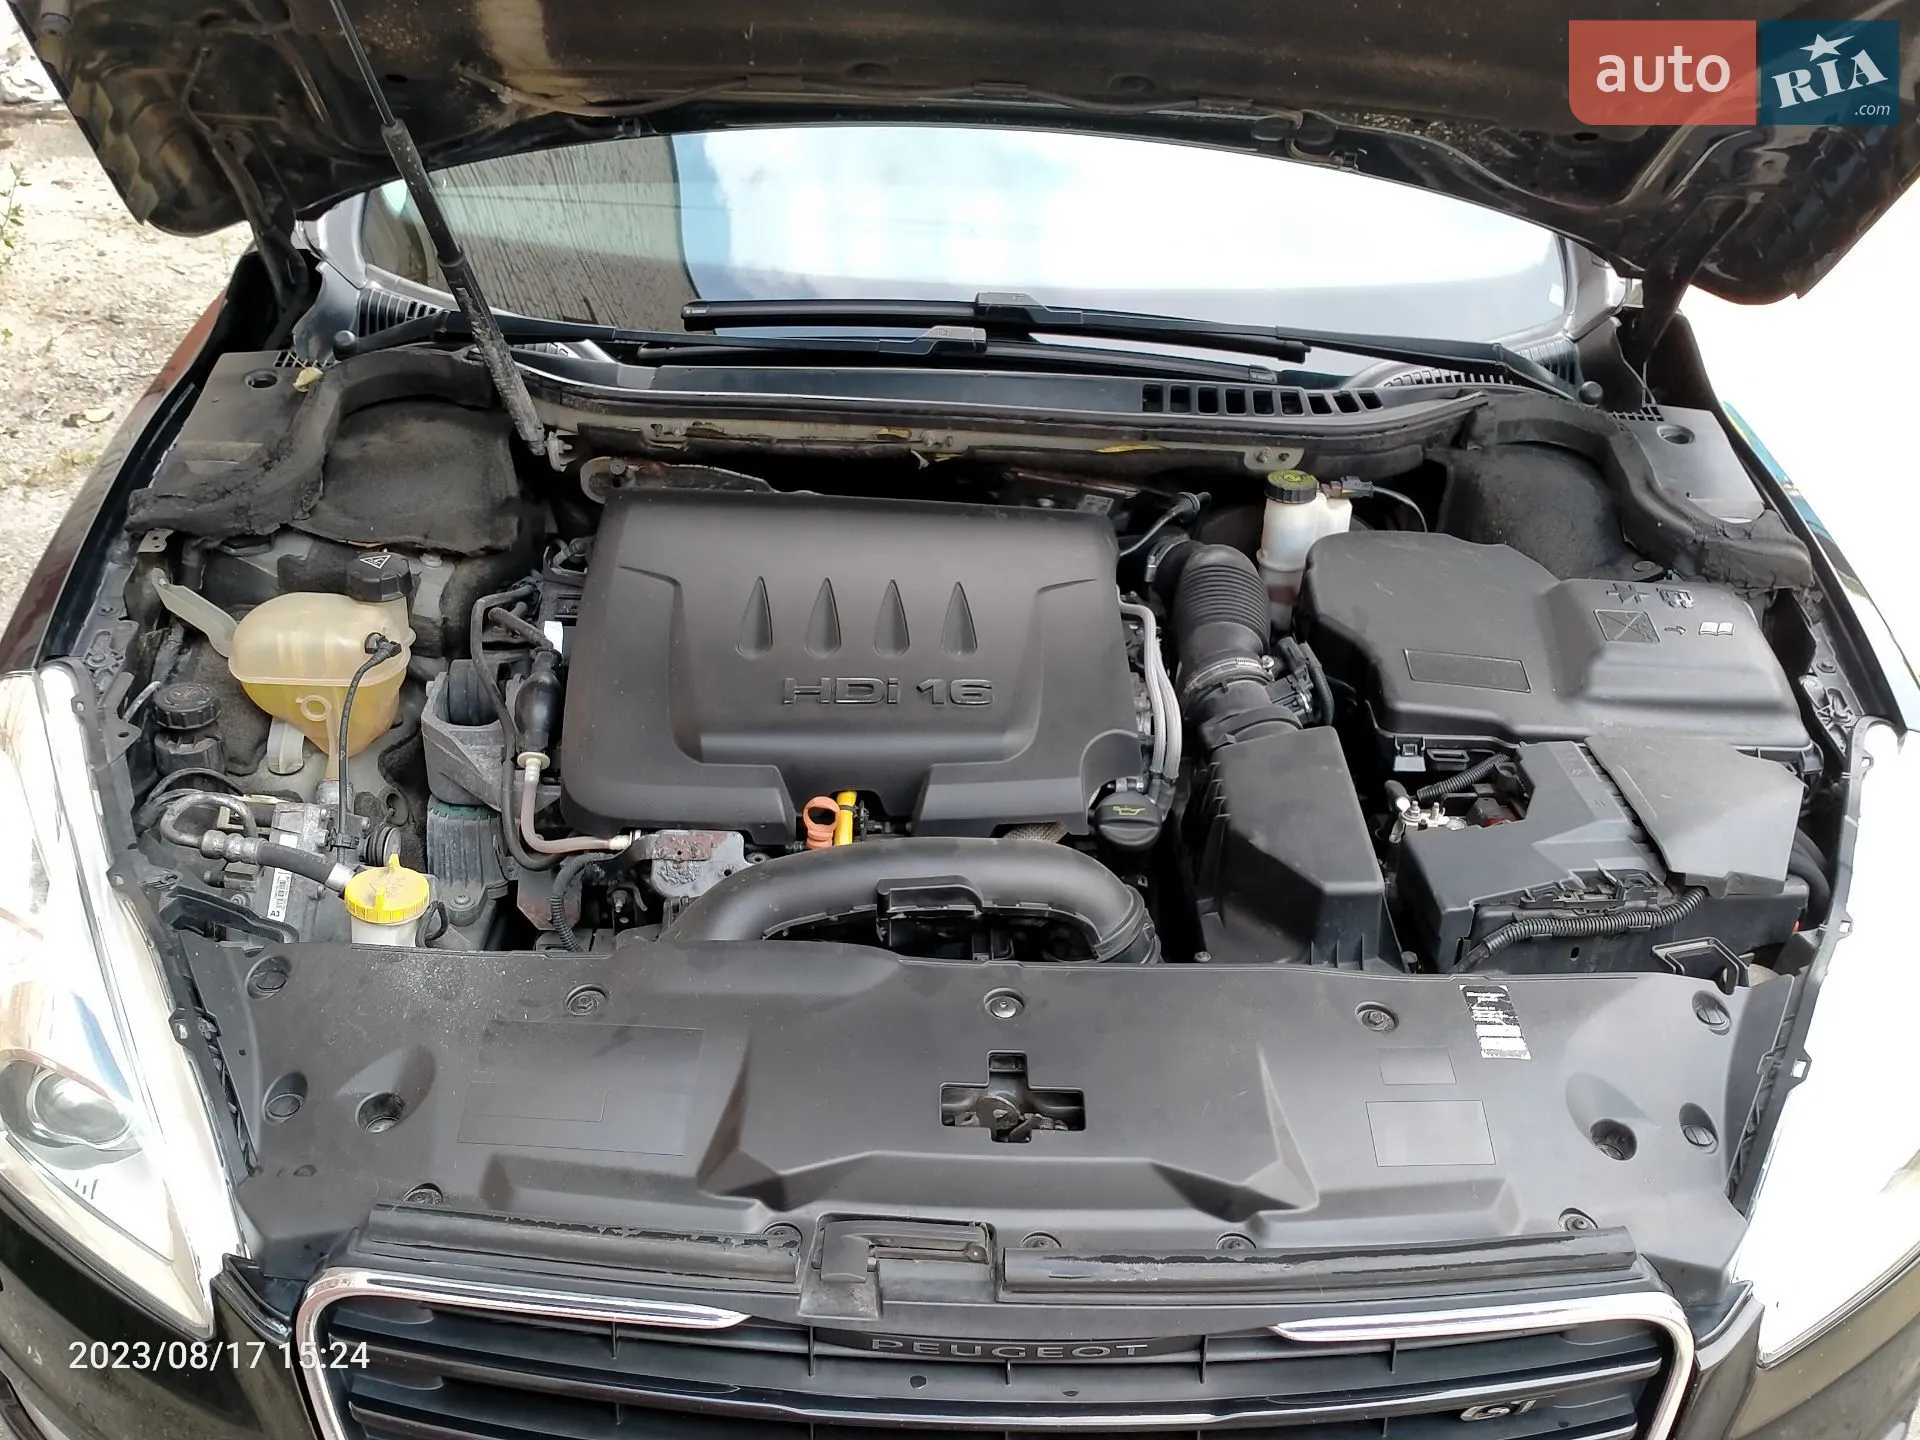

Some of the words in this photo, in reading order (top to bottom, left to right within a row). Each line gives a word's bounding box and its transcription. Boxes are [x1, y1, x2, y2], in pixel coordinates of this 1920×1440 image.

[783, 677, 899, 705] HDi
[916, 678, 994, 706] 16
[872, 1338, 1147, 1358] PEUGEOT
